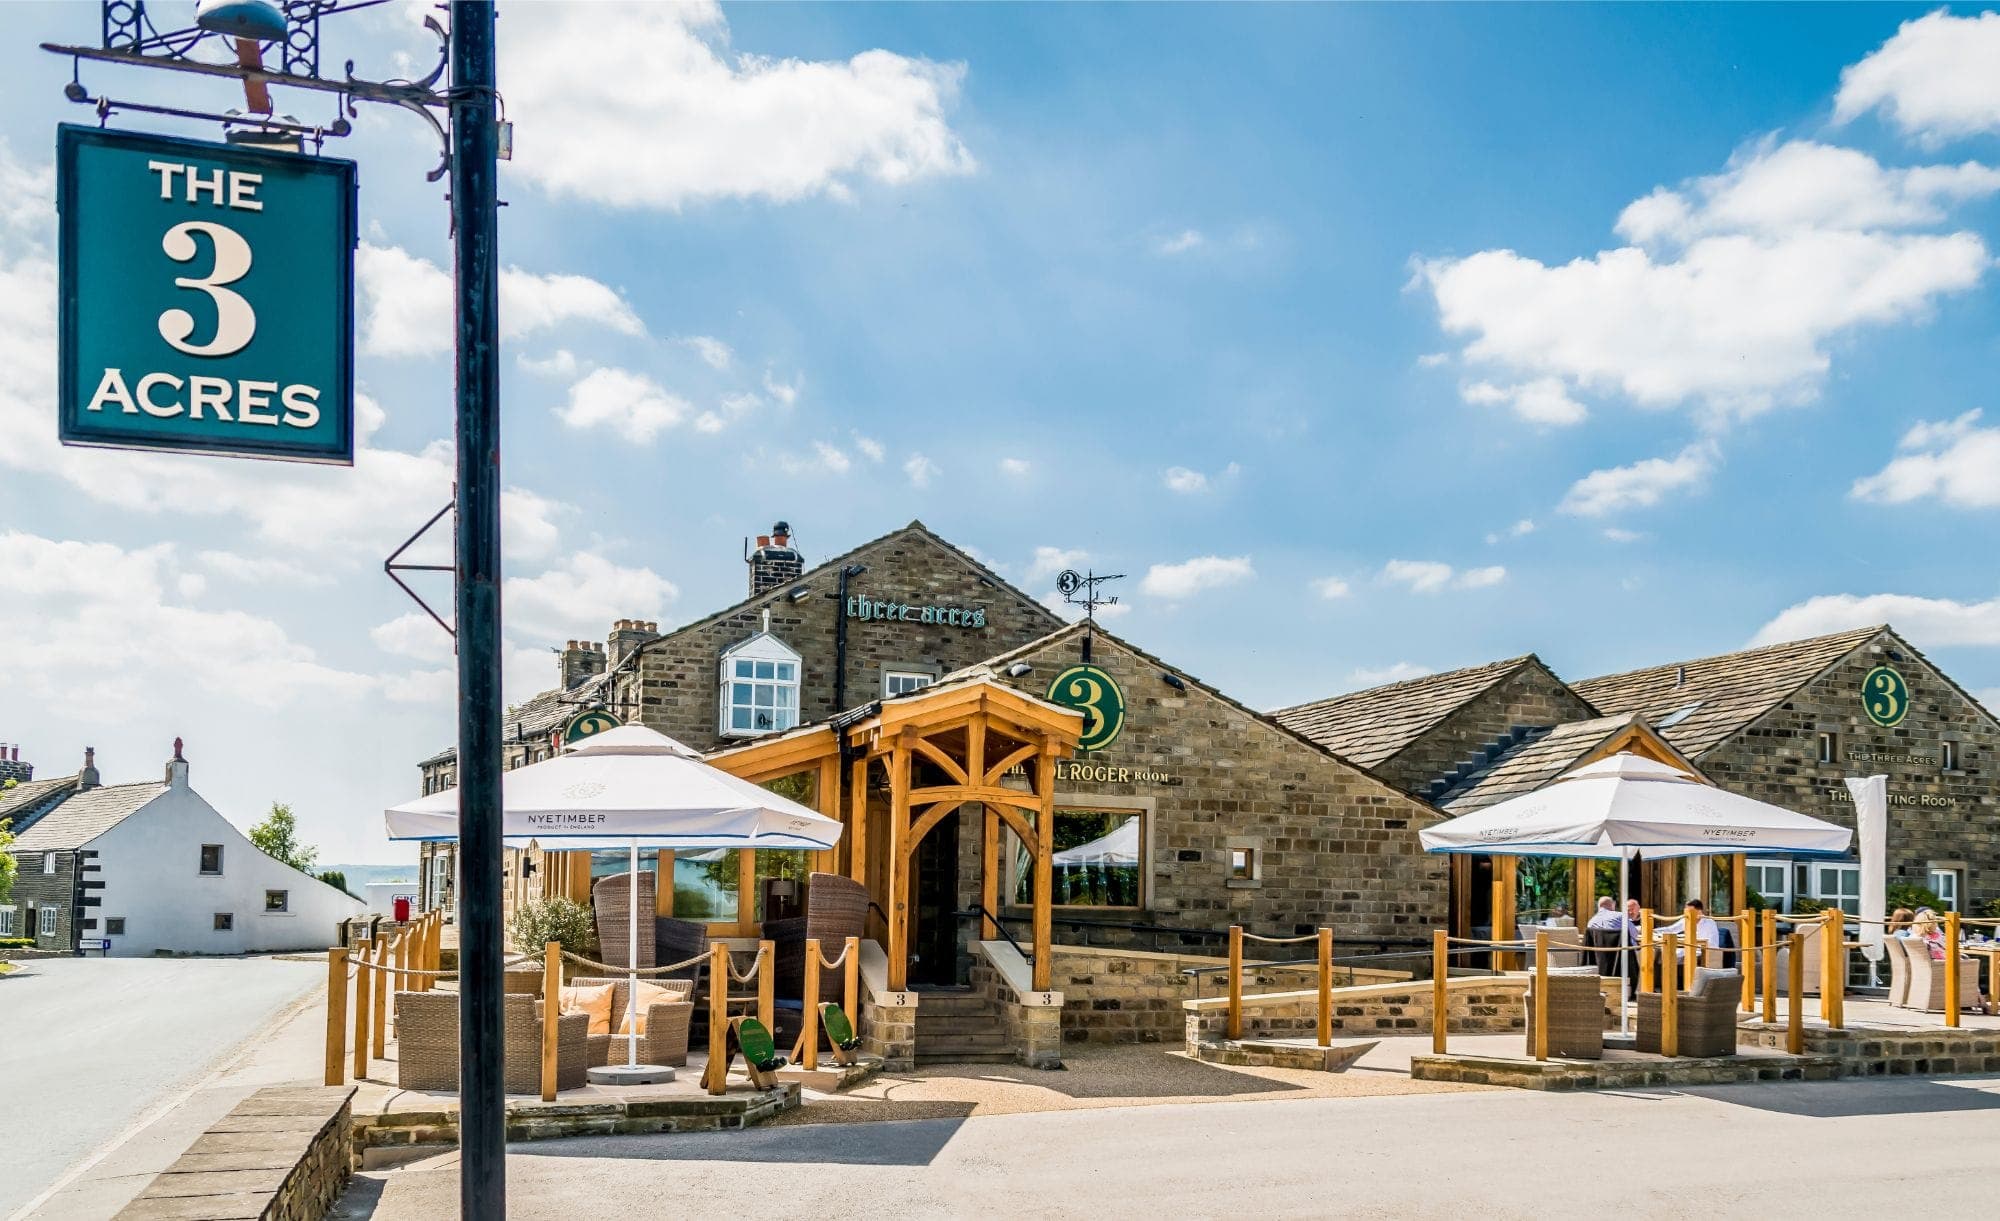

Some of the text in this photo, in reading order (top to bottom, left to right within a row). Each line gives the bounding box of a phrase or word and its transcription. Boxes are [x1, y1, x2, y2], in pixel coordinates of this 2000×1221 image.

[148, 160, 263, 211] THE
[158, 221, 256, 356] 3
[87, 367, 321, 428] ACRES
[847, 594, 985, 628] three acres
[1874, 674, 1898, 718] 3
[1069, 678, 1105, 738] 3
[1871, 753, 1902, 762] THREE
[1906, 755, 1937, 764] ACRES
[1070, 763, 1129, 782] ROGER
[1134, 771, 1169, 782] ROOM
[1921, 795, 1956, 807] ROOM
[528, 814, 606, 823] NYETIMBER
[896, 994, 906, 1006] 3
[1042, 994, 1052, 1005] 3
[1768, 1035, 1776, 1046] 3
